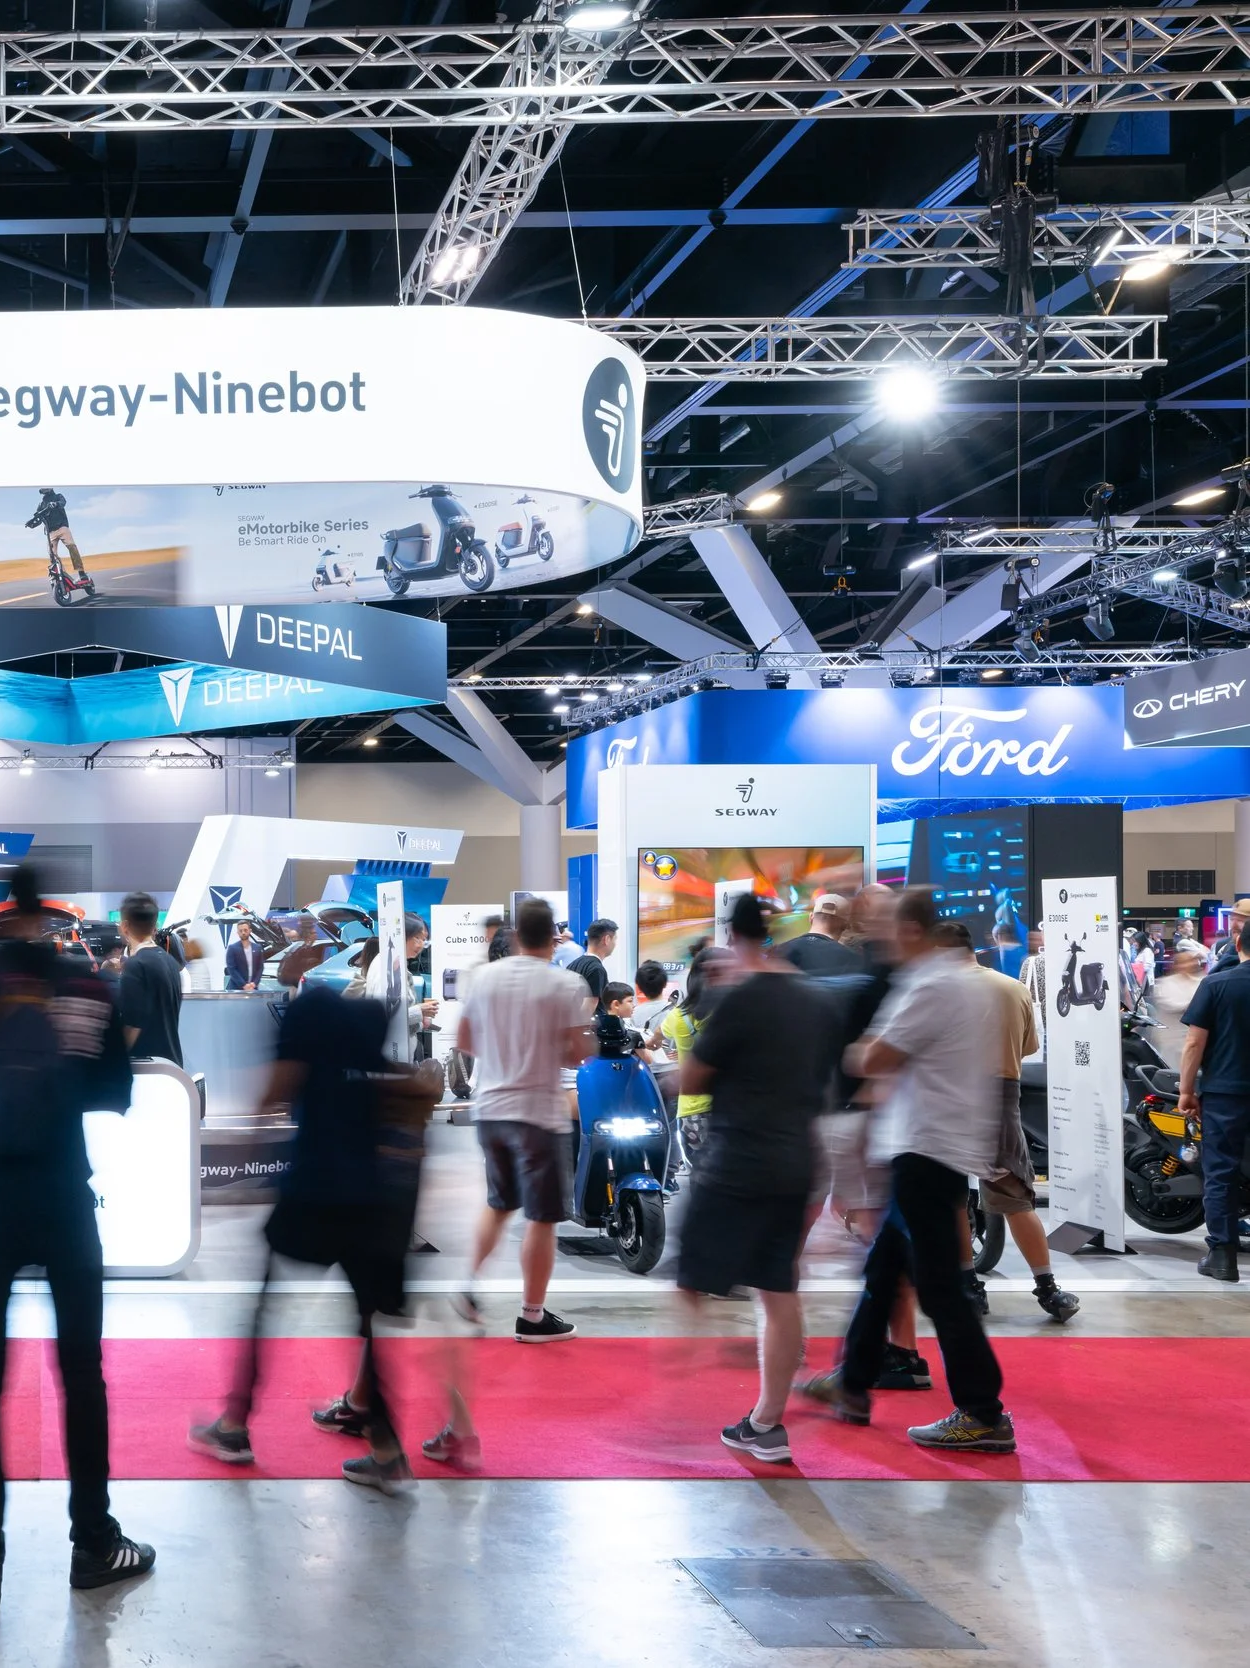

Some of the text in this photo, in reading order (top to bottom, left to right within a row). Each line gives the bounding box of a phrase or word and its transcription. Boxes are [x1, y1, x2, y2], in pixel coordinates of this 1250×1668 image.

[238, 518, 369, 535] eMotorbike Series
[238, 534, 327, 546] Be Smart Ride On
[256, 612, 363, 661] DEEPAL
[204, 672, 324, 706] DEEPAL
[1169, 679, 1247, 711] CHERY
[891, 705, 1074, 776] Ford
[715, 808, 778, 816] SEGWAY
[1048, 914, 1069, 923] E300SE
